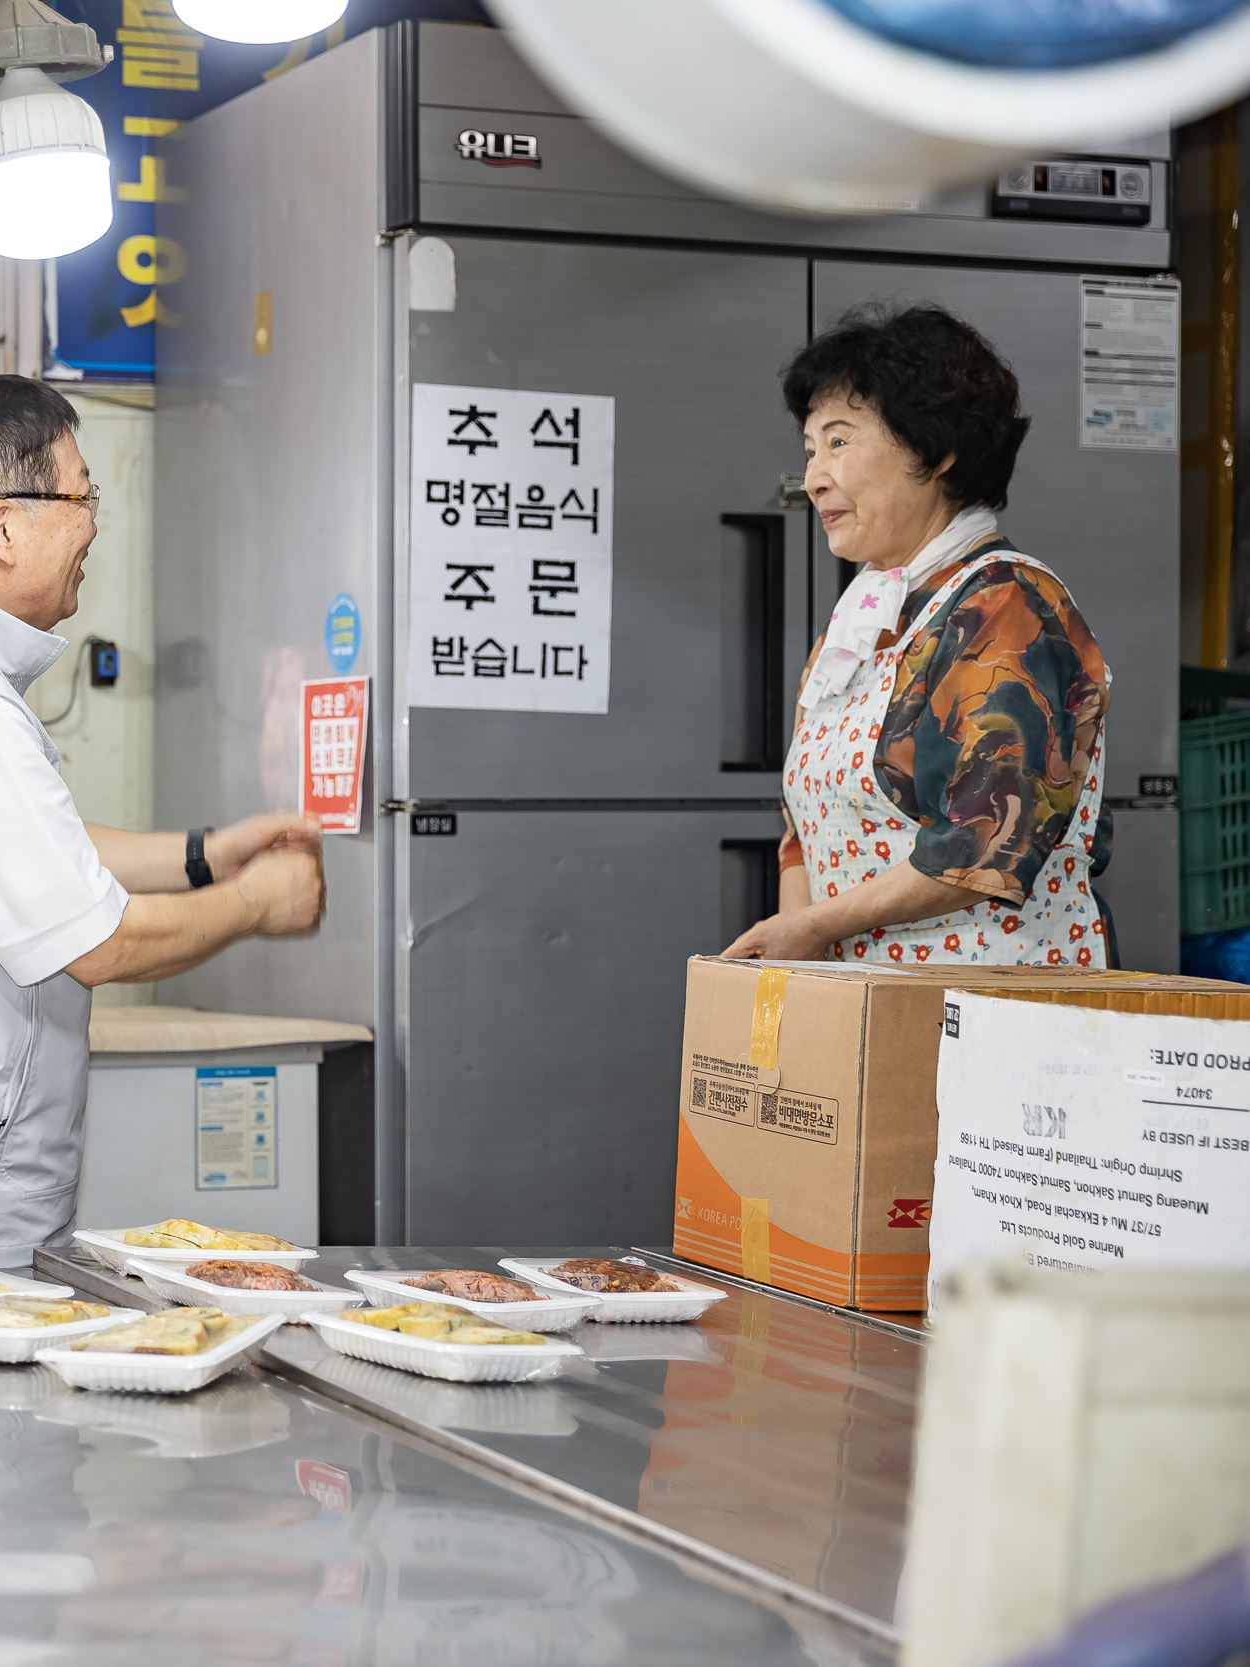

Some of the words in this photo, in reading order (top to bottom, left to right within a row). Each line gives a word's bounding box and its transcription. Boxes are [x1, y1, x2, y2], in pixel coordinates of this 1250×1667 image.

[456, 129, 541, 160] 유니크
[425, 478, 600, 535] 명절음식
[431, 635, 590, 682] 받습니다
[1150, 1049, 1199, 1068] DATE:
[1204, 1053, 1250, 1072] PROD
[708, 1089, 749, 1113] 간편사전접수
[1175, 1086, 1213, 1100] 34074
[778, 1105, 835, 1129] 비대면방문소포
[1022, 1104, 1067, 1140] KR
[960, 1131, 977, 1146] 1166
[979, 1137, 991, 1150] TH
[1141, 1129, 1157, 1143] BY
[1160, 1131, 1195, 1147] USED
[1197, 1135, 1211, 1148] IF
[1214, 1137, 1250, 1152] BEST
[992, 1136, 1023, 1156] Raised)
[1026, 1145, 1053, 1163] (Farm
[949, 1154, 977, 1174] Thailand
[979, 1162, 1002, 1178] 74000
[1056, 1151, 1098, 1170] Thailand
[1101, 1158, 1136, 1176] Origin:
[1004, 1167, 1039, 1187] Sakhon
[1139, 1163, 1183, 1182] Shrimp
[1040, 1175, 1070, 1193] Samut
[1074, 1180, 1114, 1200] Sakhon,
[972, 1186, 997, 1204] Kham,
[999, 1193, 1022, 1209] Khok
[1118, 1190, 1153, 1207] Samut
[1157, 1193, 1208, 1215] Mueang
[1025, 1197, 1051, 1216] Road,
[1055, 1205, 1099, 1226] Ekkachai
[697, 1206, 728, 1227] KOREA
[1101, 1215, 1109, 1227] 4
[1110, 1217, 1127, 1232] Mu
[999, 1220, 1016, 1234] Ltd.
[1018, 1225, 1061, 1245] Products
[1131, 1221, 1161, 1236] 57/37
[1063, 1234, 1086, 1250] Gold
[1089, 1240, 1124, 1259] Marine
